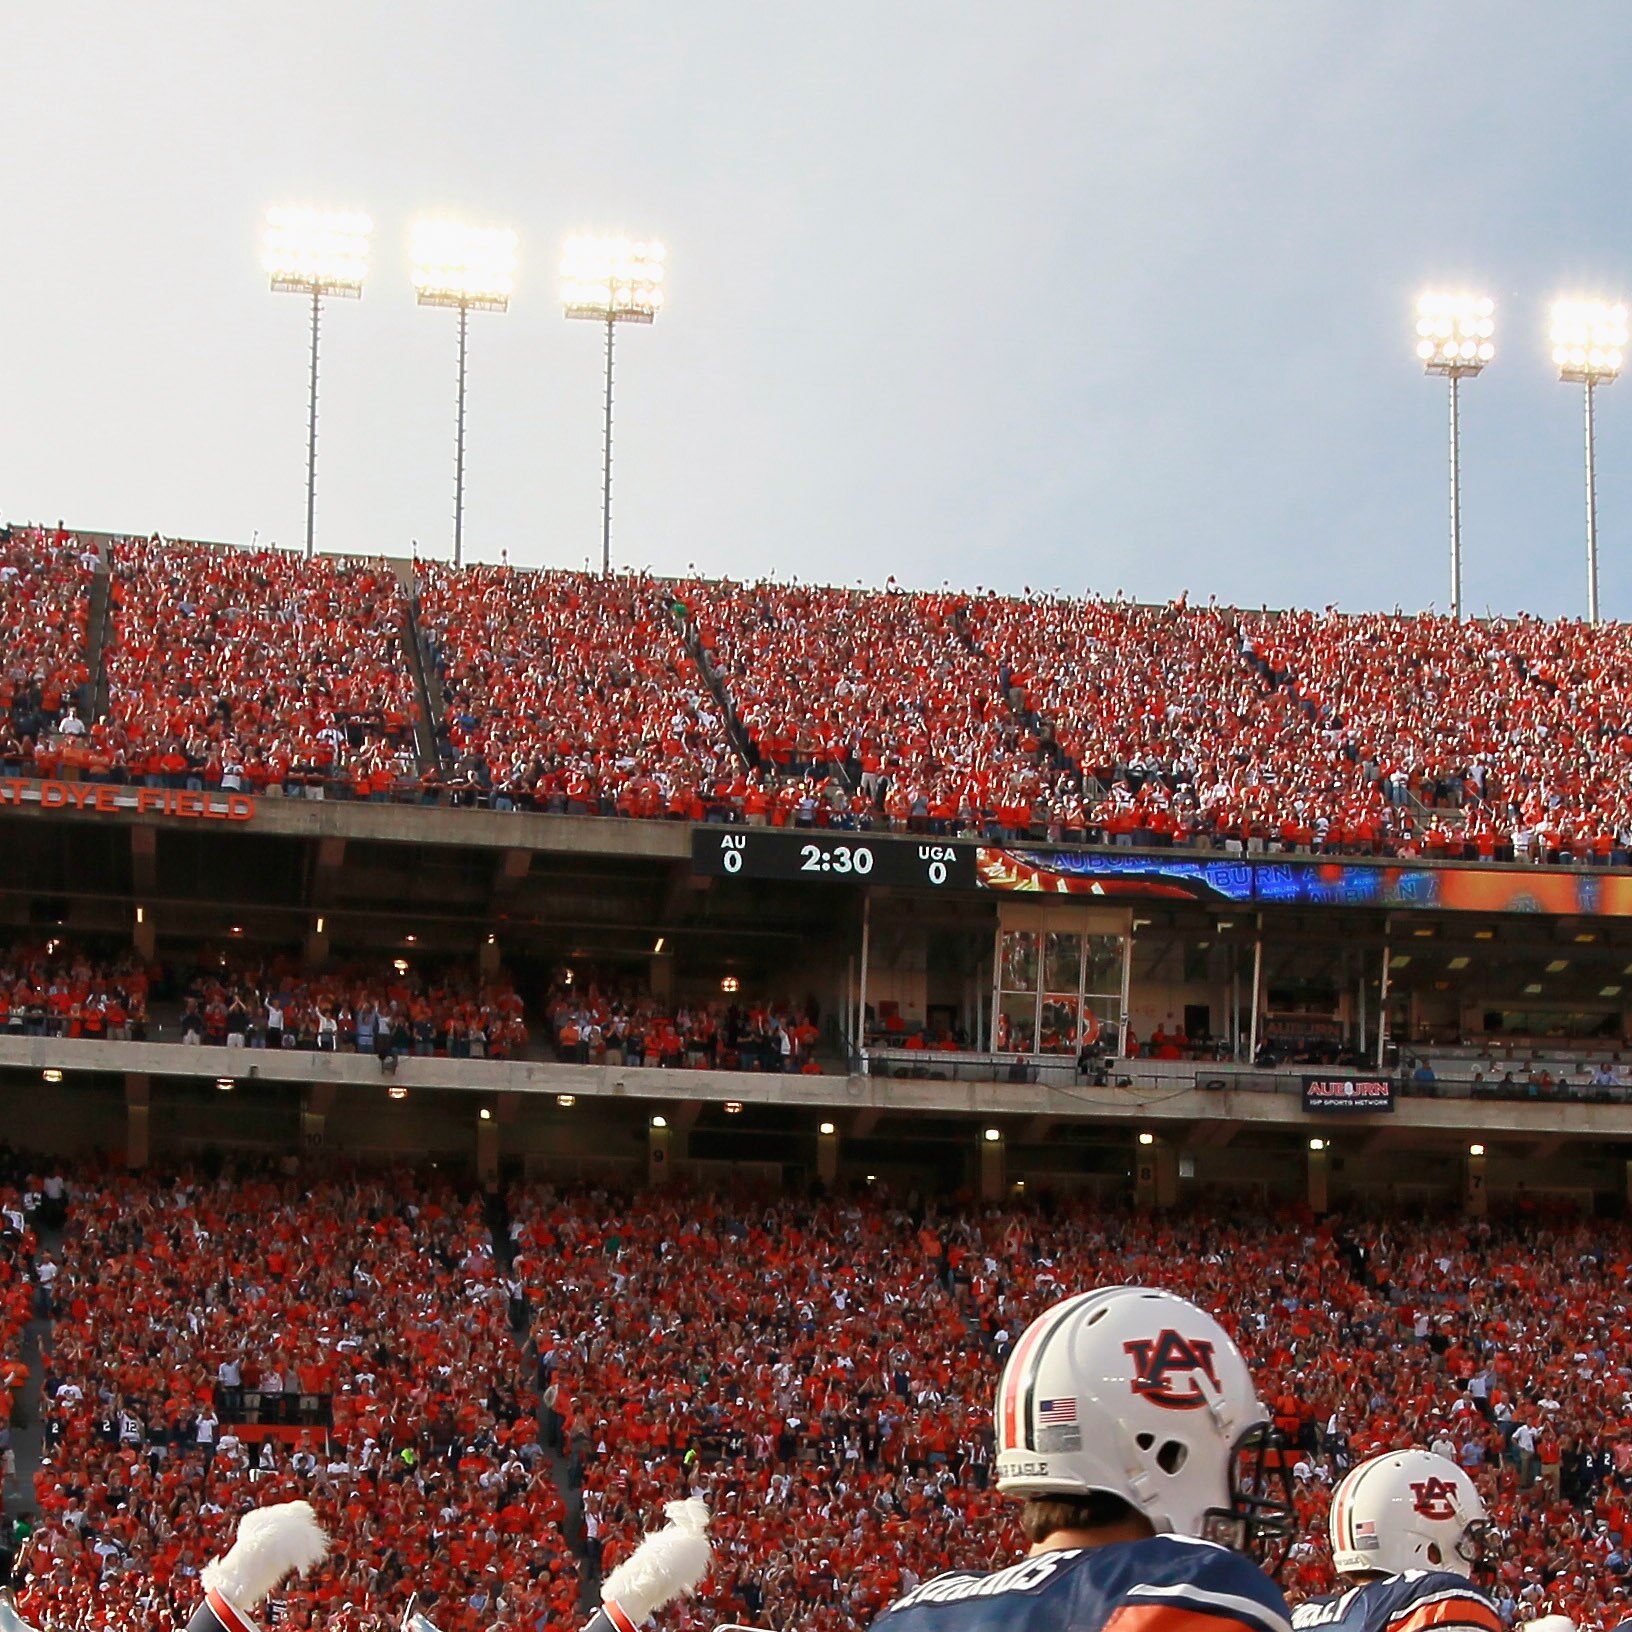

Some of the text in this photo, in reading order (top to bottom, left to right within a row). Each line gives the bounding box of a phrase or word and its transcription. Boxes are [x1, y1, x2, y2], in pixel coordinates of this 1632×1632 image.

[40, 781, 120, 812] DYE
[137, 788, 255, 821] FIELD
[720, 835, 746, 850] AU
[801, 845, 874, 875] 2:30
[919, 846, 956, 862] UGA
[723, 850, 743, 873] 0
[928, 862, 947, 885] 0
[654, 1149, 664, 1163] 9
[1473, 1175, 1482, 1188] 7
[52, 1423, 59, 1433] 2
[103, 1420, 110, 1431] 2
[125, 1421, 137, 1433] 12
[1586, 1456, 1593, 1467] 2
[1604, 1453, 1610, 1465] 2
